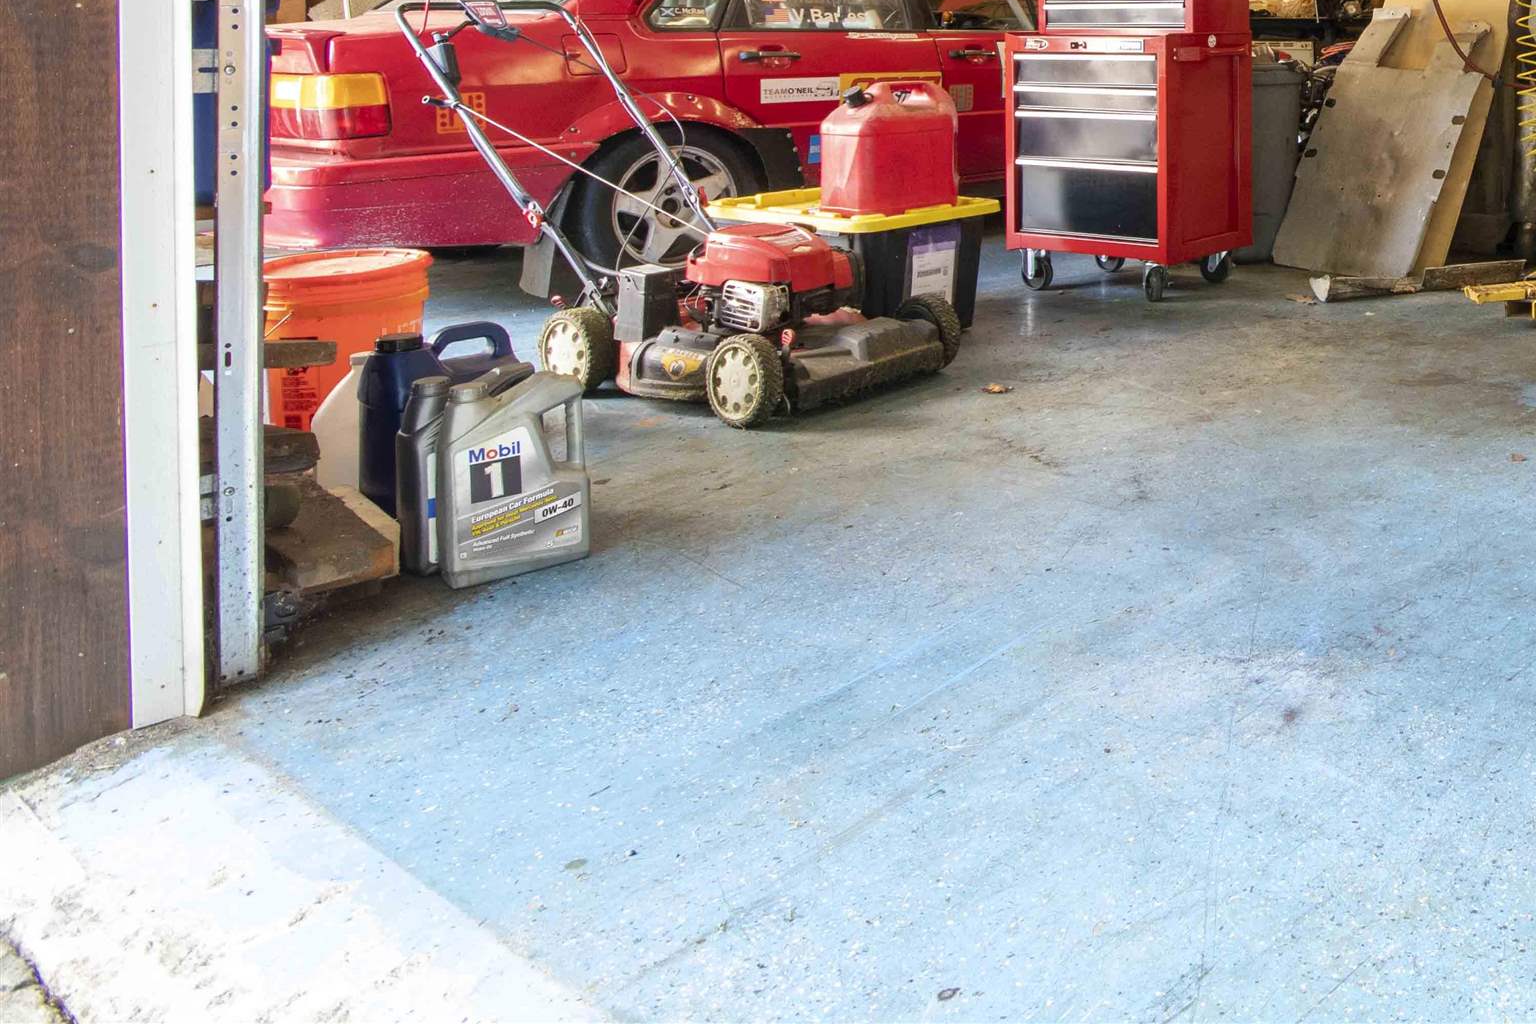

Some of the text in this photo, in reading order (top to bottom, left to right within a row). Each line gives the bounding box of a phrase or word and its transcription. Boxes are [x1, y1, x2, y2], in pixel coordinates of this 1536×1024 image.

[792, 7, 867, 24] V.Bares
[468, 441, 520, 464] Mobil
[484, 462, 504, 498] 1
[471, 506, 509, 524] European
[509, 499, 523, 510] Car
[523, 488, 555, 507] Formula
[542, 497, 575, 518] 0W-40
